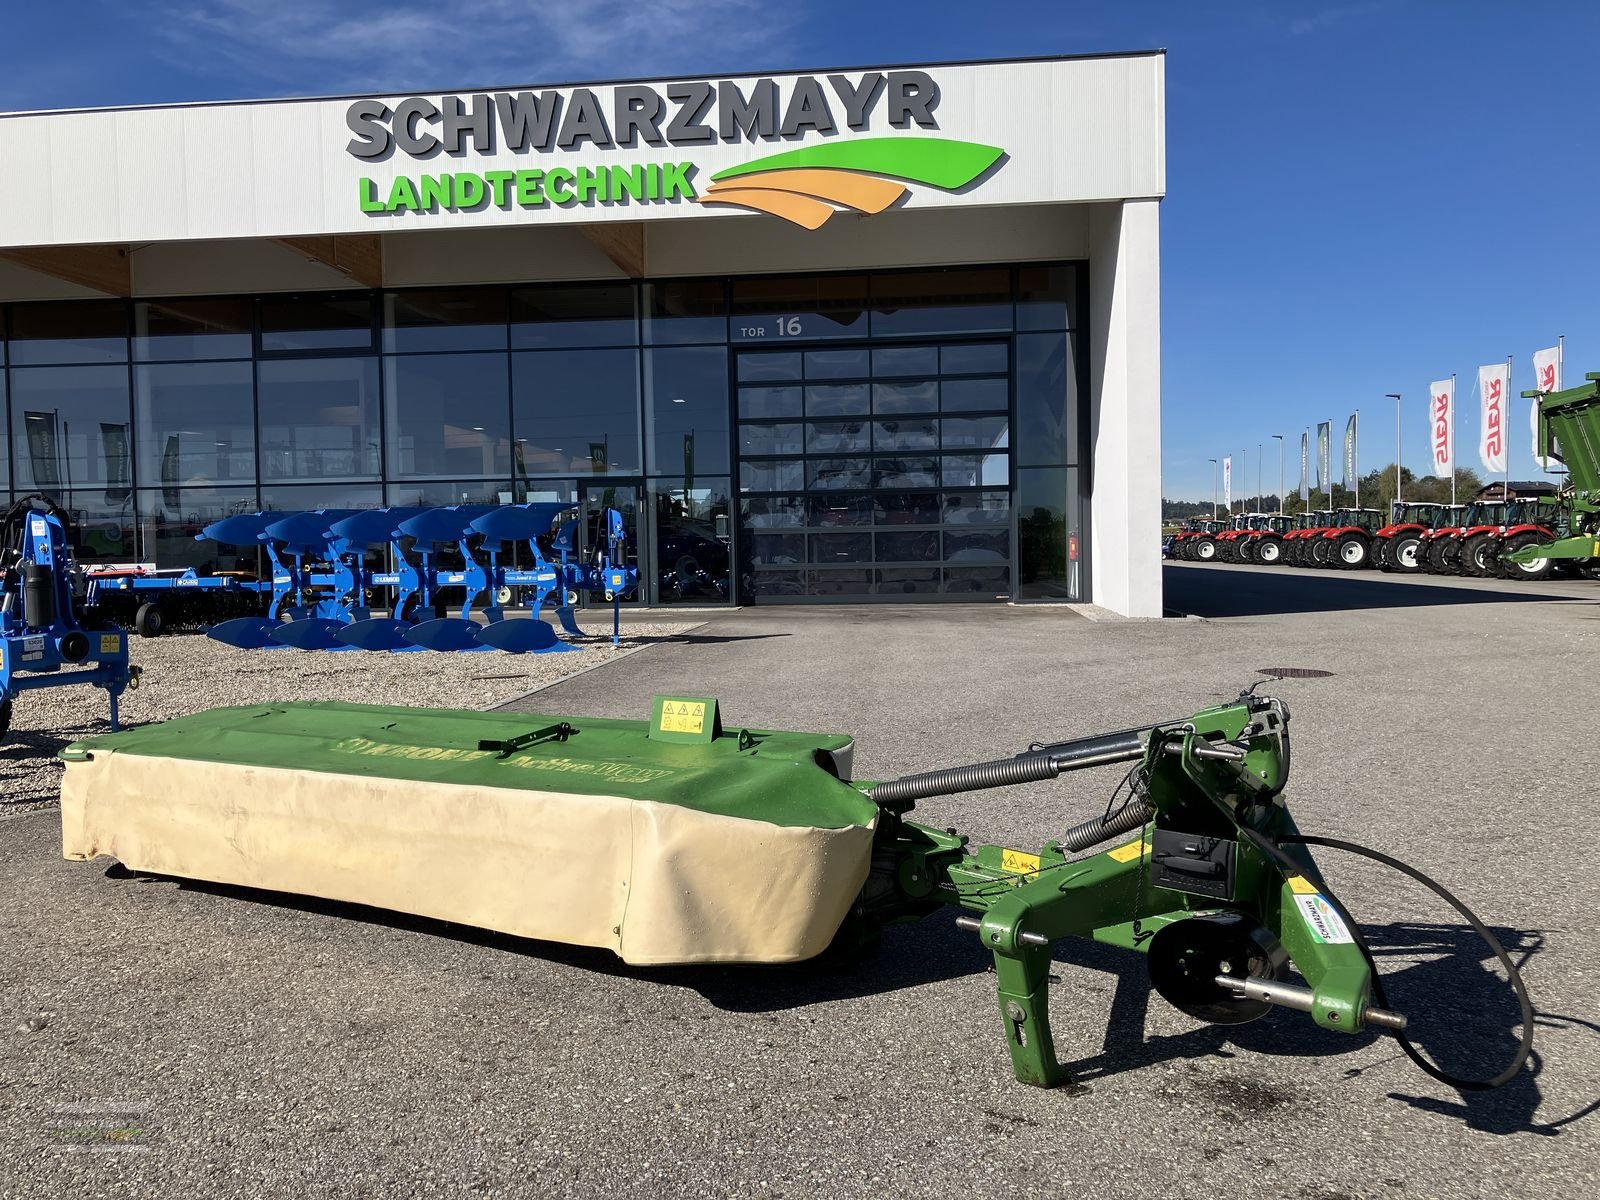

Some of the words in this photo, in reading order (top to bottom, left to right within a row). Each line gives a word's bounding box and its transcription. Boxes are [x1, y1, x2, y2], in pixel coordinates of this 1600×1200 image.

[346, 70, 941, 159] SCHWARZMAYR
[359, 161, 697, 215] LANDTECHNIK
[740, 327, 765, 337] TOR
[776, 316, 802, 336] 16
[1306, 900, 1331, 939] SCHWARZMAYR
